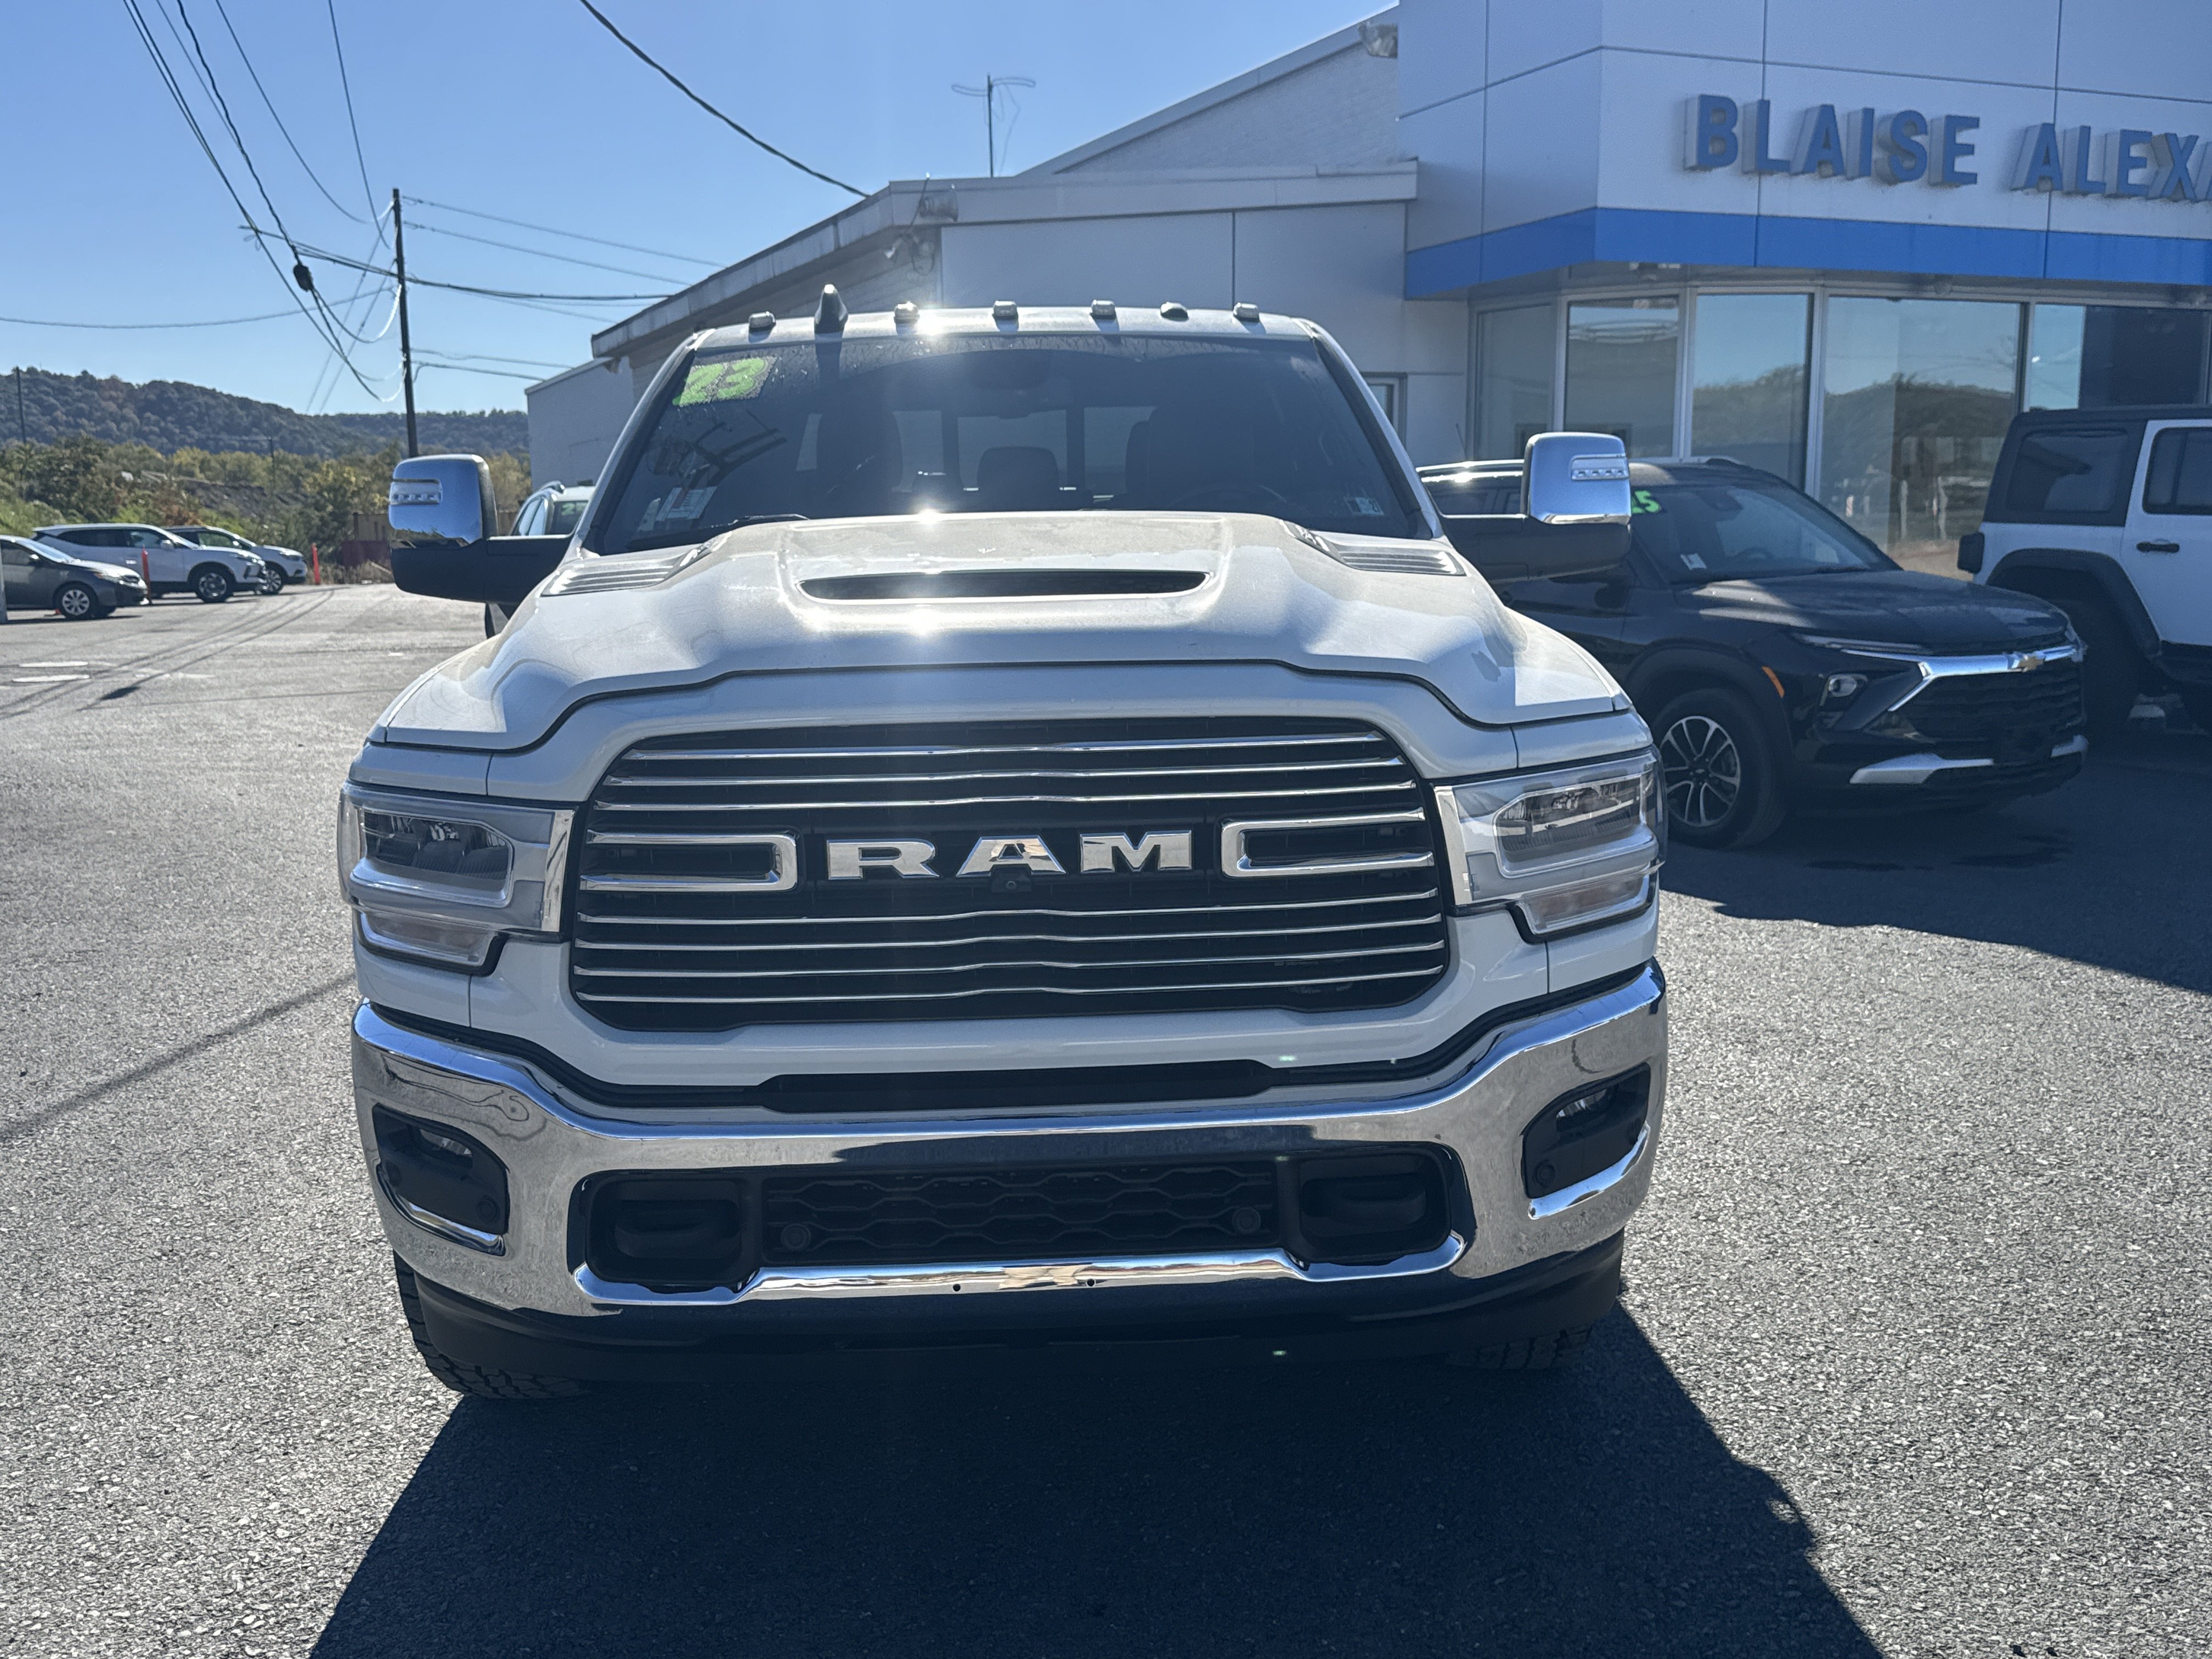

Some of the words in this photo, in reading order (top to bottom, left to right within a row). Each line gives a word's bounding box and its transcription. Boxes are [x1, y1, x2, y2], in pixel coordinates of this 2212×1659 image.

[1685, 94, 1980, 187] BLAISE
[2012, 123, 2212, 201] ALEX
[827, 829, 1192, 879] RAM
